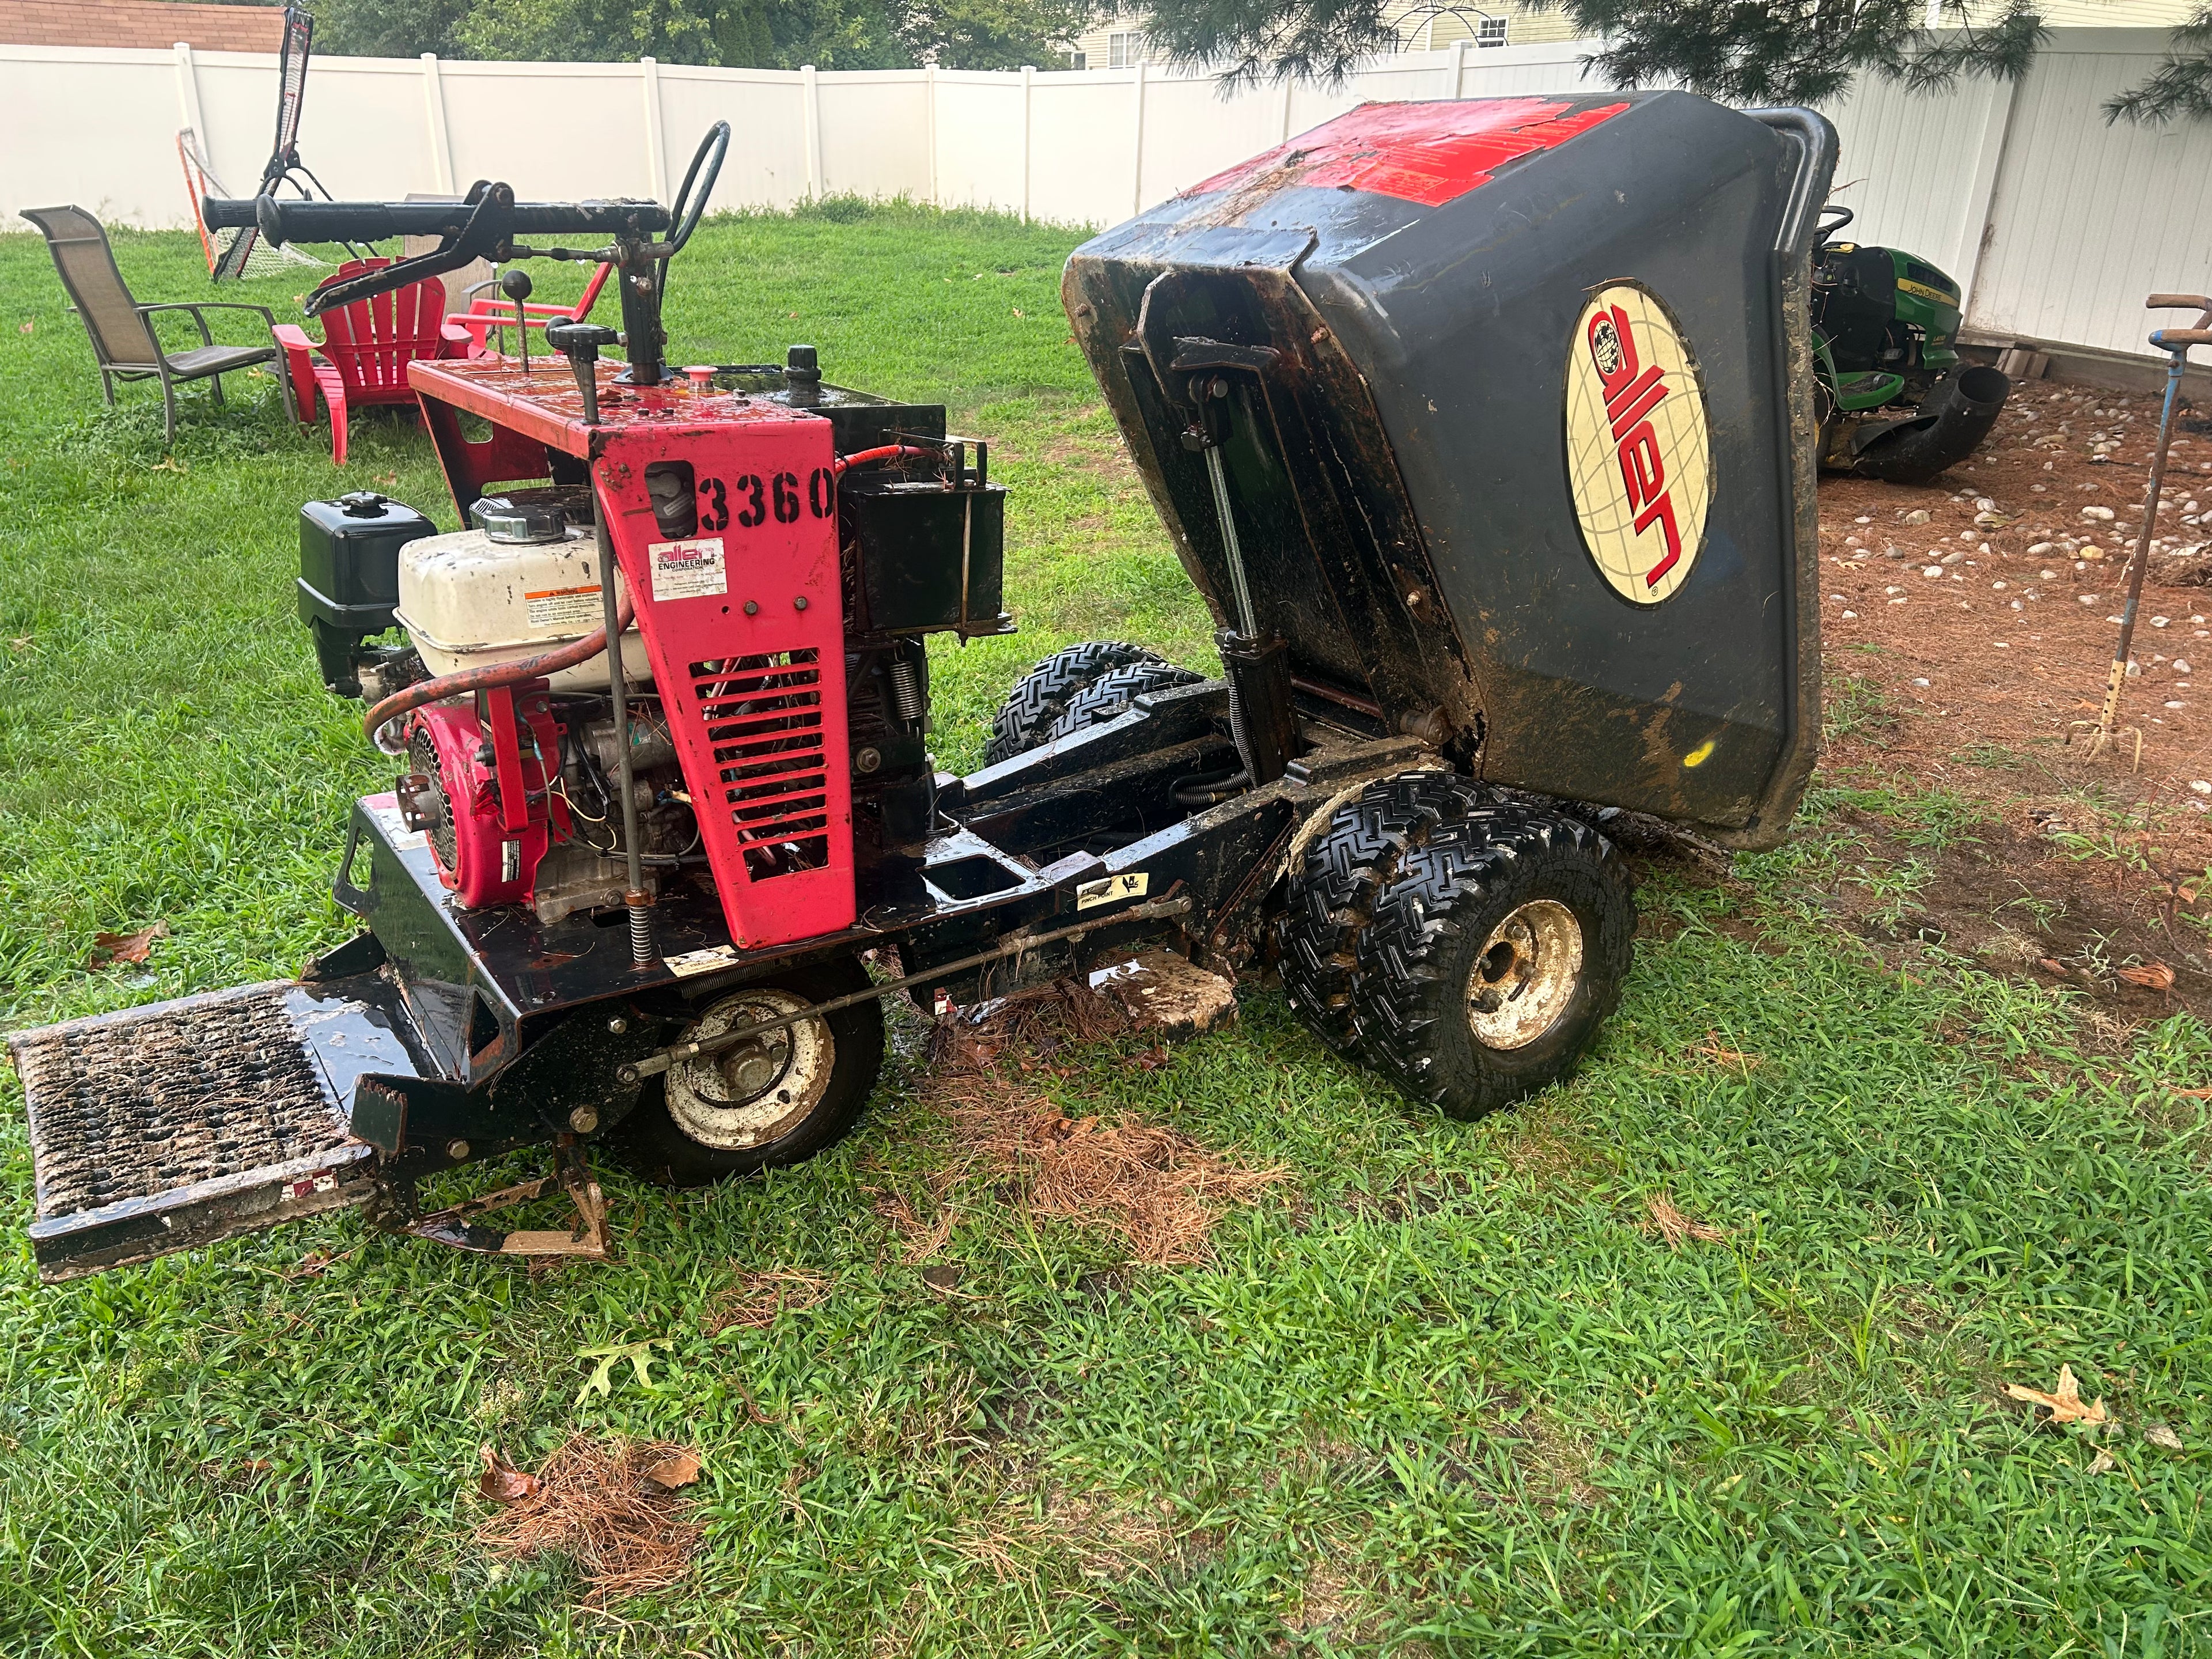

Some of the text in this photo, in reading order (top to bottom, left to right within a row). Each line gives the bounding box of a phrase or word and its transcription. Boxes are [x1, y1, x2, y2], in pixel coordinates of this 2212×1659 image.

[1908, 285, 1942, 301] JOHN DEERE
[1588, 302, 1681, 590] allen
[699, 467, 834, 531] 3360
[657, 545, 715, 562] allen
[658, 558, 715, 570] ENGINEERING
[1081, 896, 1097, 904] PINCH
